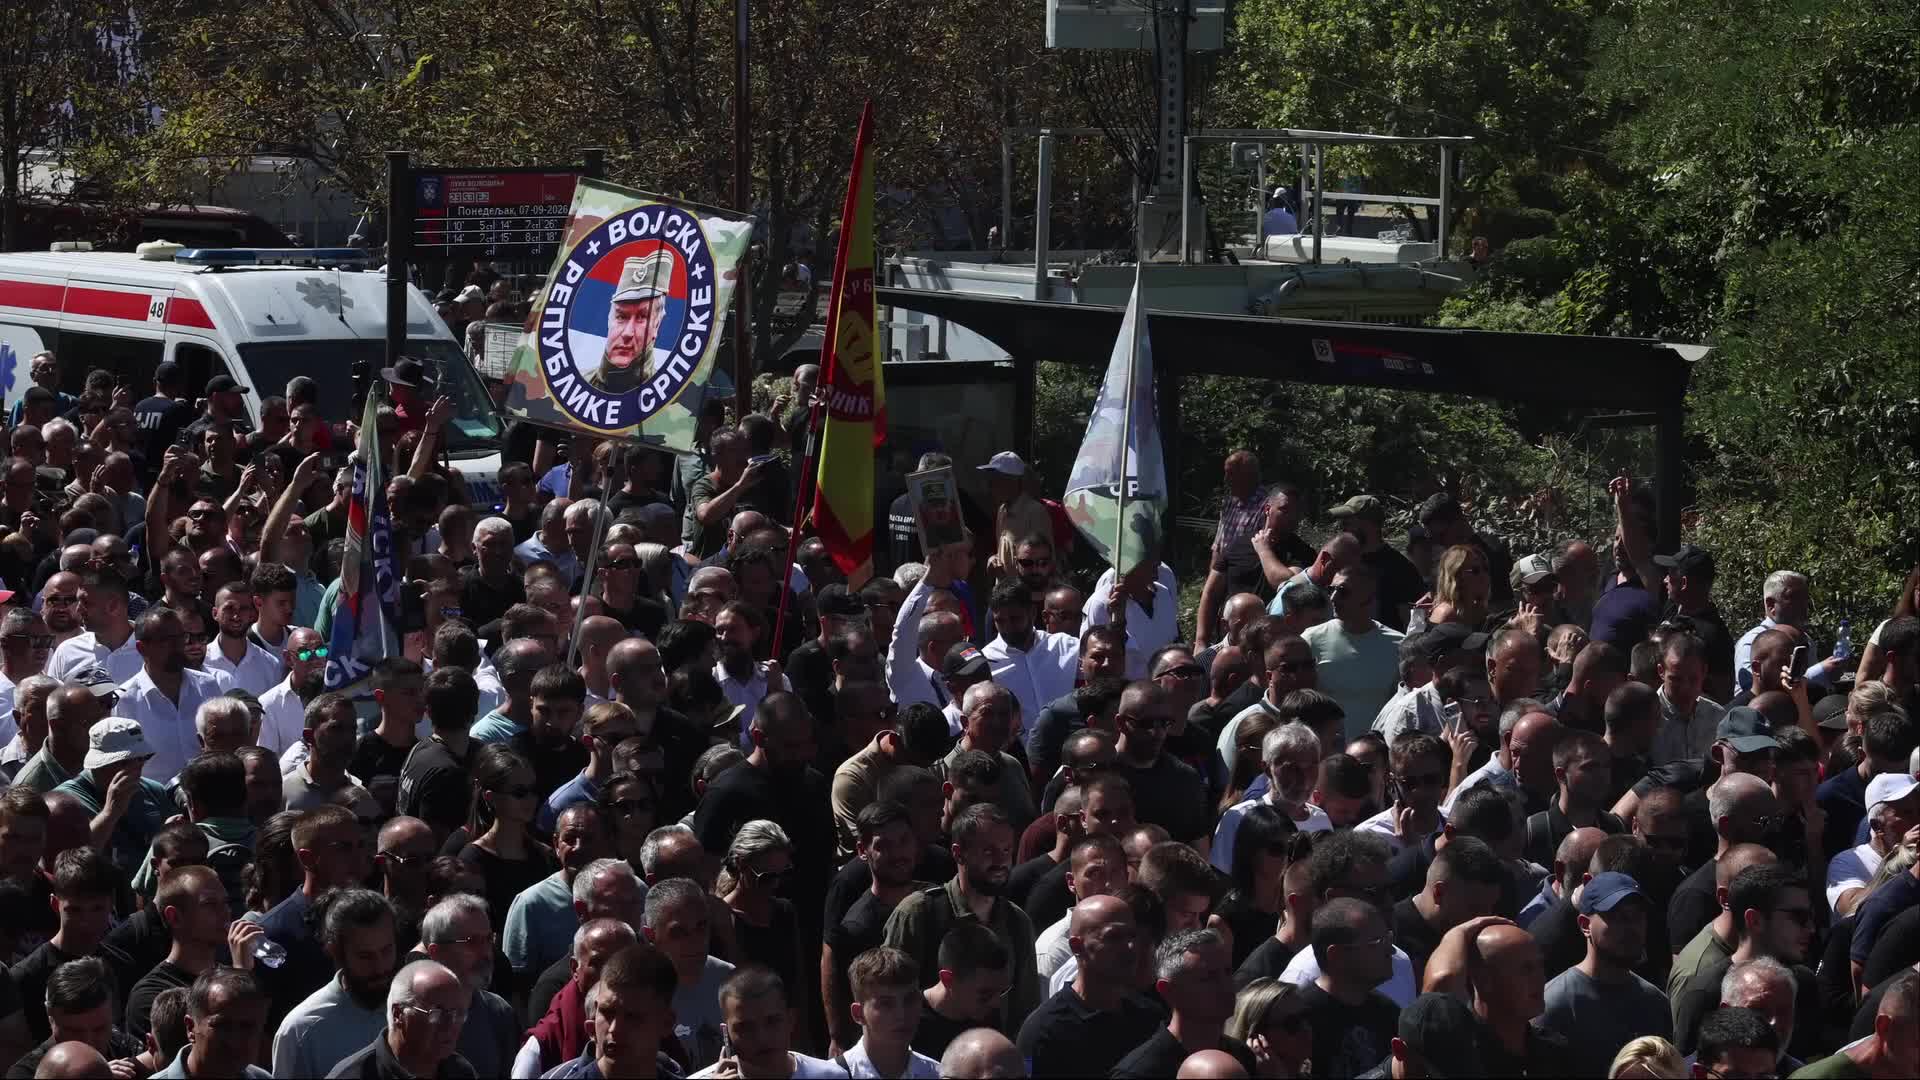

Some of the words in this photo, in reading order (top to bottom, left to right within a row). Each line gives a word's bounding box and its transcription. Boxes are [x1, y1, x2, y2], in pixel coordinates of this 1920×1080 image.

[519, 204, 568, 215] 07-09-2026
[608, 211, 700, 264] ВОЈСКА
[150, 302, 164, 318] 48
[542, 259, 622, 425] РЕПУБЛИКЕ
[638, 284, 712, 413] СРПСКЕ
